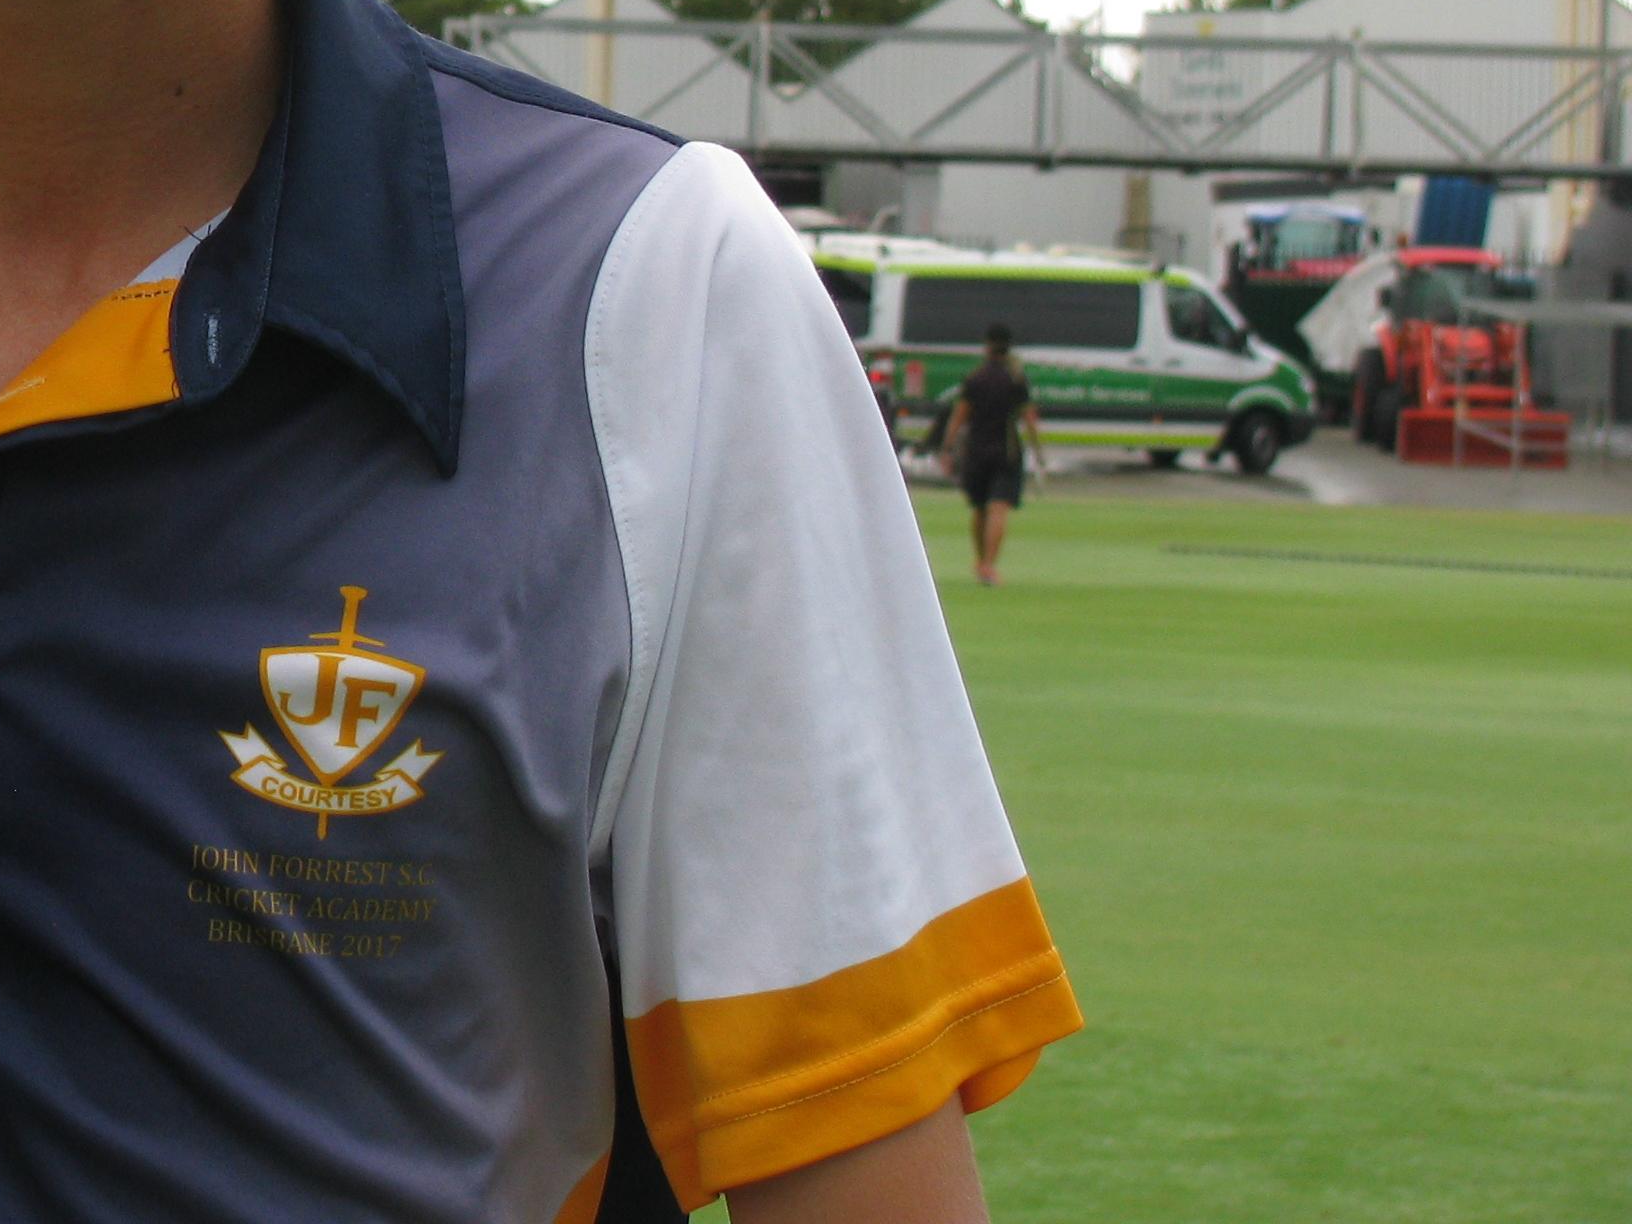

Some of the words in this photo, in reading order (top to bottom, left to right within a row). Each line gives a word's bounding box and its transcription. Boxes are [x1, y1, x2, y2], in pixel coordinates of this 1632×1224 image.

[279, 654, 396, 748] JF
[260, 776, 399, 810] COURTESY
[191, 844, 260, 875] JOHN
[268, 854, 393, 885] FORREST
[187, 879, 302, 918] CRICKET
[307, 896, 437, 922] ACADEMY
[207, 918, 334, 957] BRISBANE
[340, 935, 404, 958] 2017
